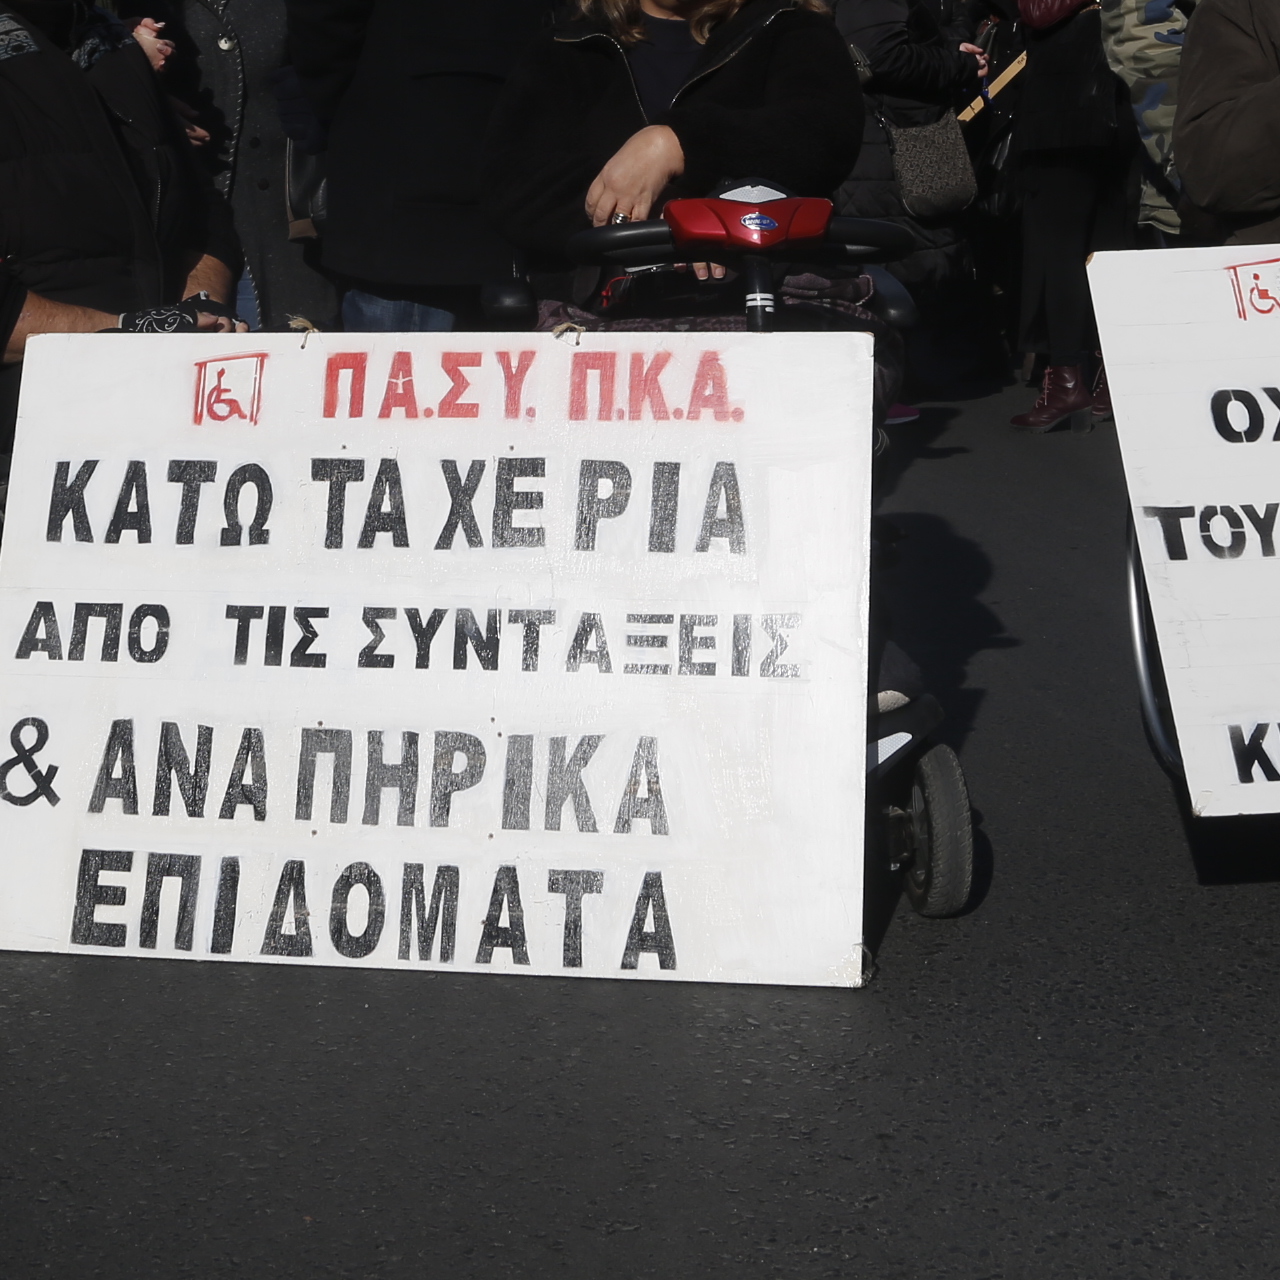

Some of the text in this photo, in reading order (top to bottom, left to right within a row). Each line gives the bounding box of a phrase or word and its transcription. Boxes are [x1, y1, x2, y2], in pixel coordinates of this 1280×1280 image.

[46, 458, 747, 554] ΚΑΤΩ ΤΑ ΧΕΡΙΑ
[1143, 503, 1280, 561] ΤΟΥ
[16, 600, 803, 680] ΑΠΟ ΤΙΣ ΣΥΝΤΑΞΕΙΣ
[87, 718, 669, 836] ΑΝΑΠΗΡΙΚΑ
[70, 849, 677, 971] ΕΠΙΔΟΜΑΤΑ
